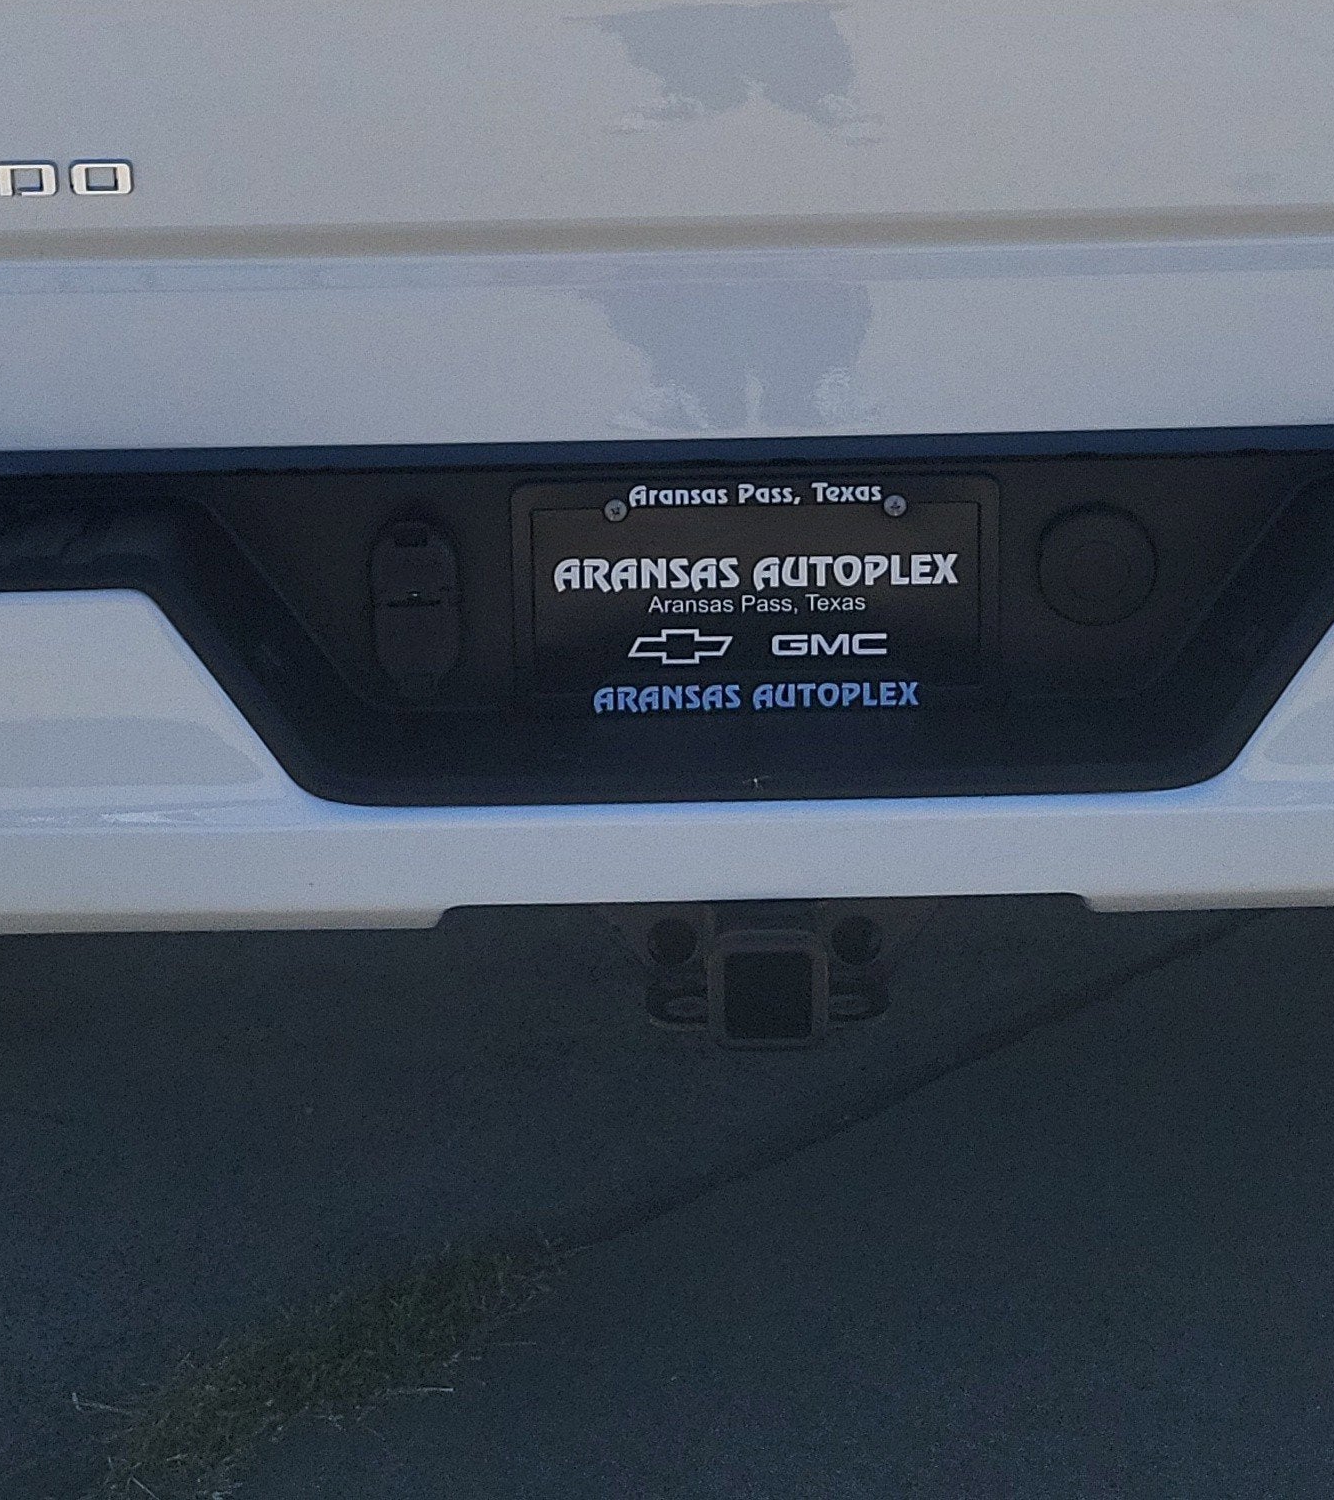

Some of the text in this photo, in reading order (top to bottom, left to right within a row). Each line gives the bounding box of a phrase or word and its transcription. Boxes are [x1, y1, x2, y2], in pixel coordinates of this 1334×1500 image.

[628, 482, 882, 507] Aransas Pass, Texas
[554, 553, 958, 592] ARANSAS AUTOPLEX
[648, 594, 866, 614] Aransas Pass, Texas
[772, 633, 888, 656] GMC
[593, 681, 919, 713] ARANSAS AUTOPLEX
